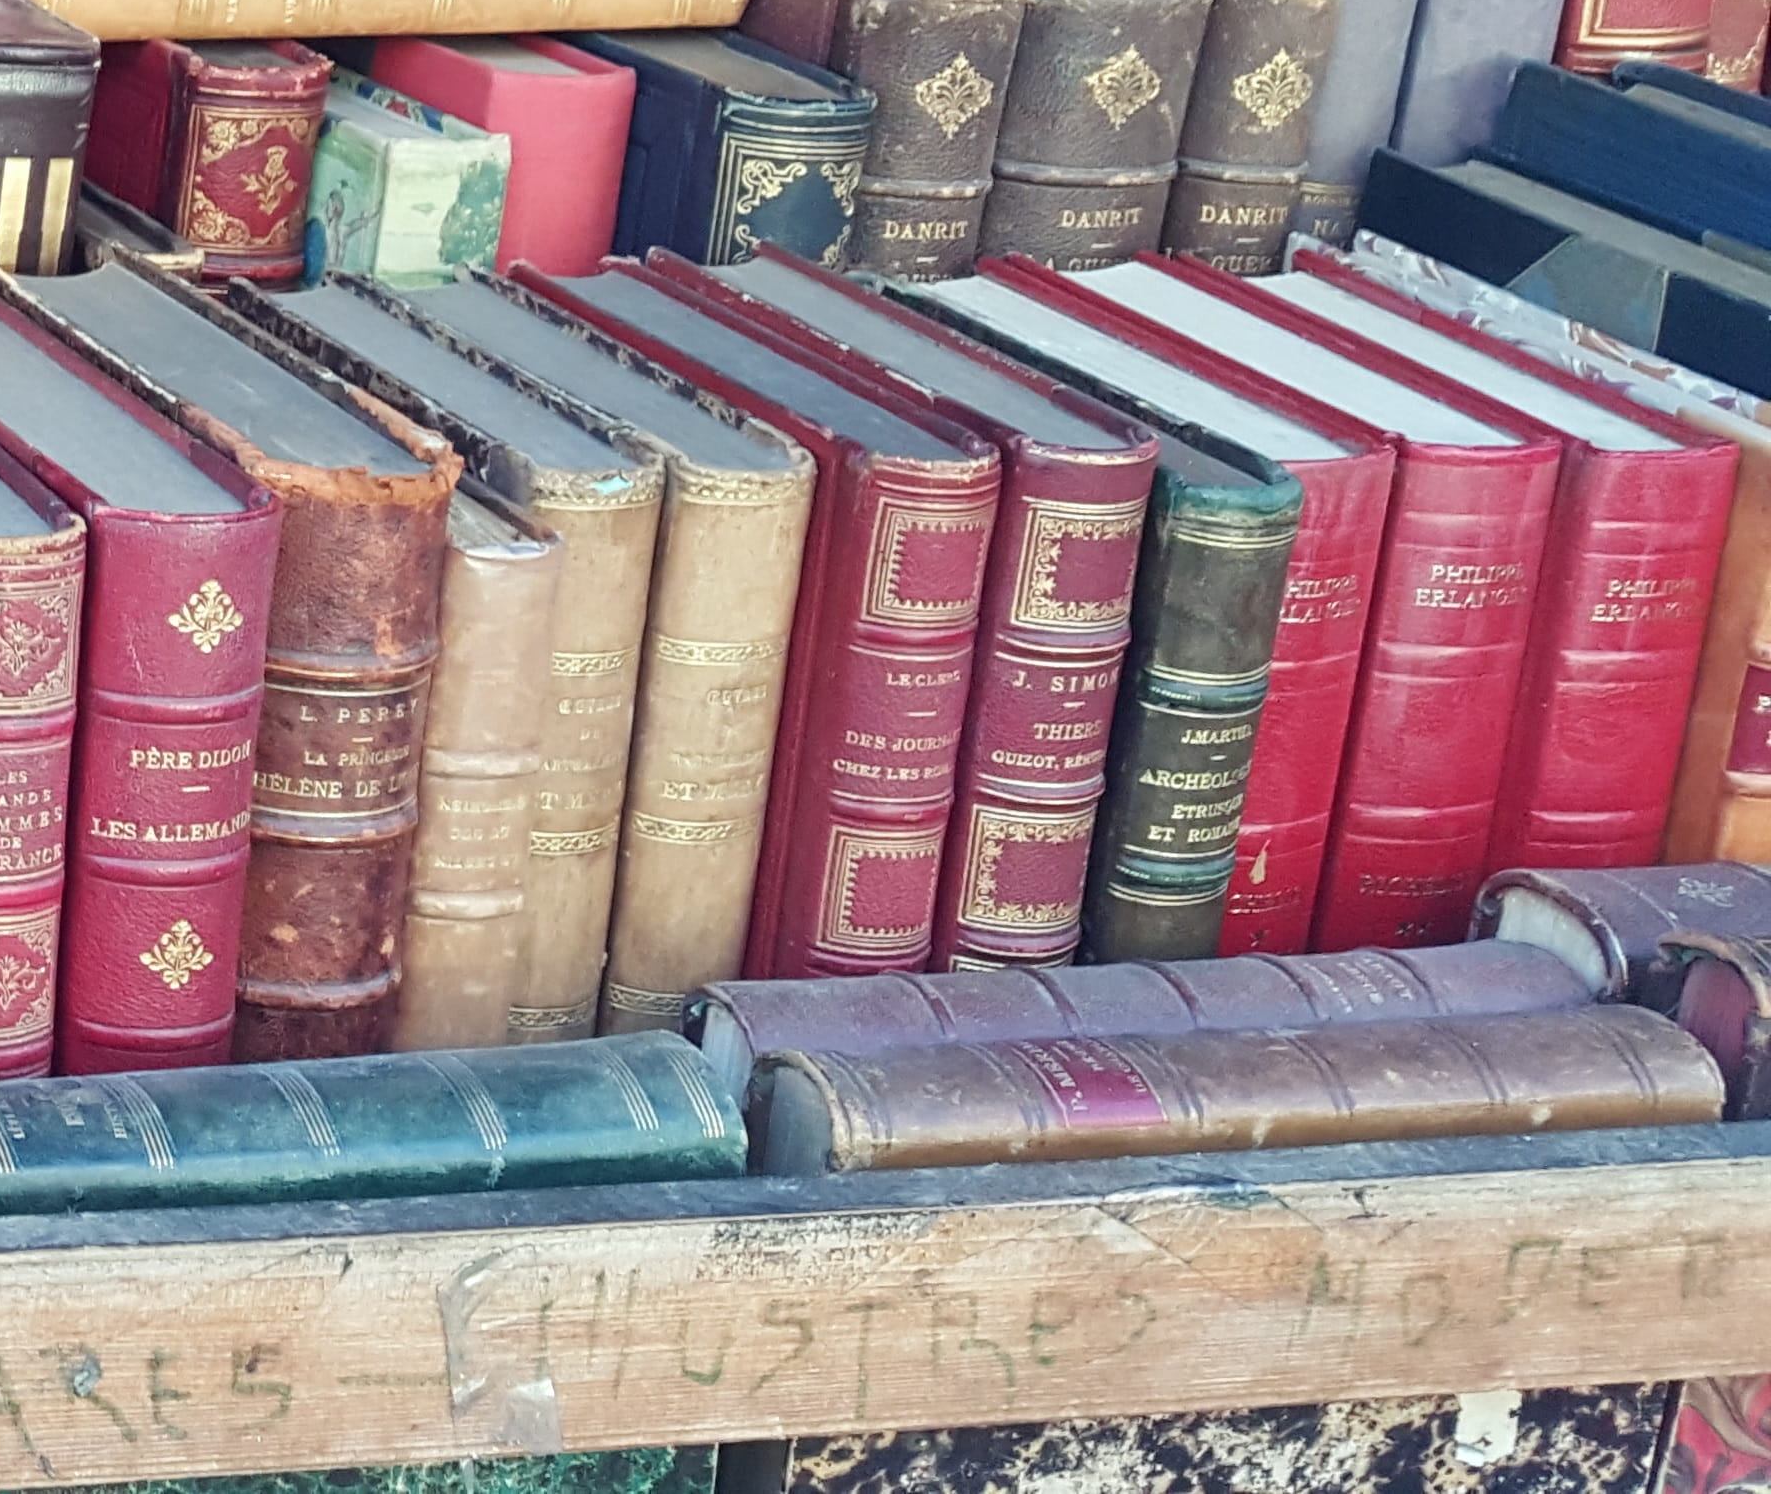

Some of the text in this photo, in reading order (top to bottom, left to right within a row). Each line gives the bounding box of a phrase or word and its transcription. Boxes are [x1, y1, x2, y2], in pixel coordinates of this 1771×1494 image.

[1060, 206, 1144, 229] DANRIT
[1198, 204, 1289, 227] DANRIT
[883, 219, 969, 241] DANRIT
[300, 697, 420, 725] L. PEREY
[845, 728, 888, 752] DES
[129, 738, 252, 770] PÈRE DIDON
[303, 749, 328, 766] LA
[832, 757, 922, 781] CHEZ LES
[252, 770, 382, 800] HÉLÈNE DE
[1148, 825, 1176, 843] ET
